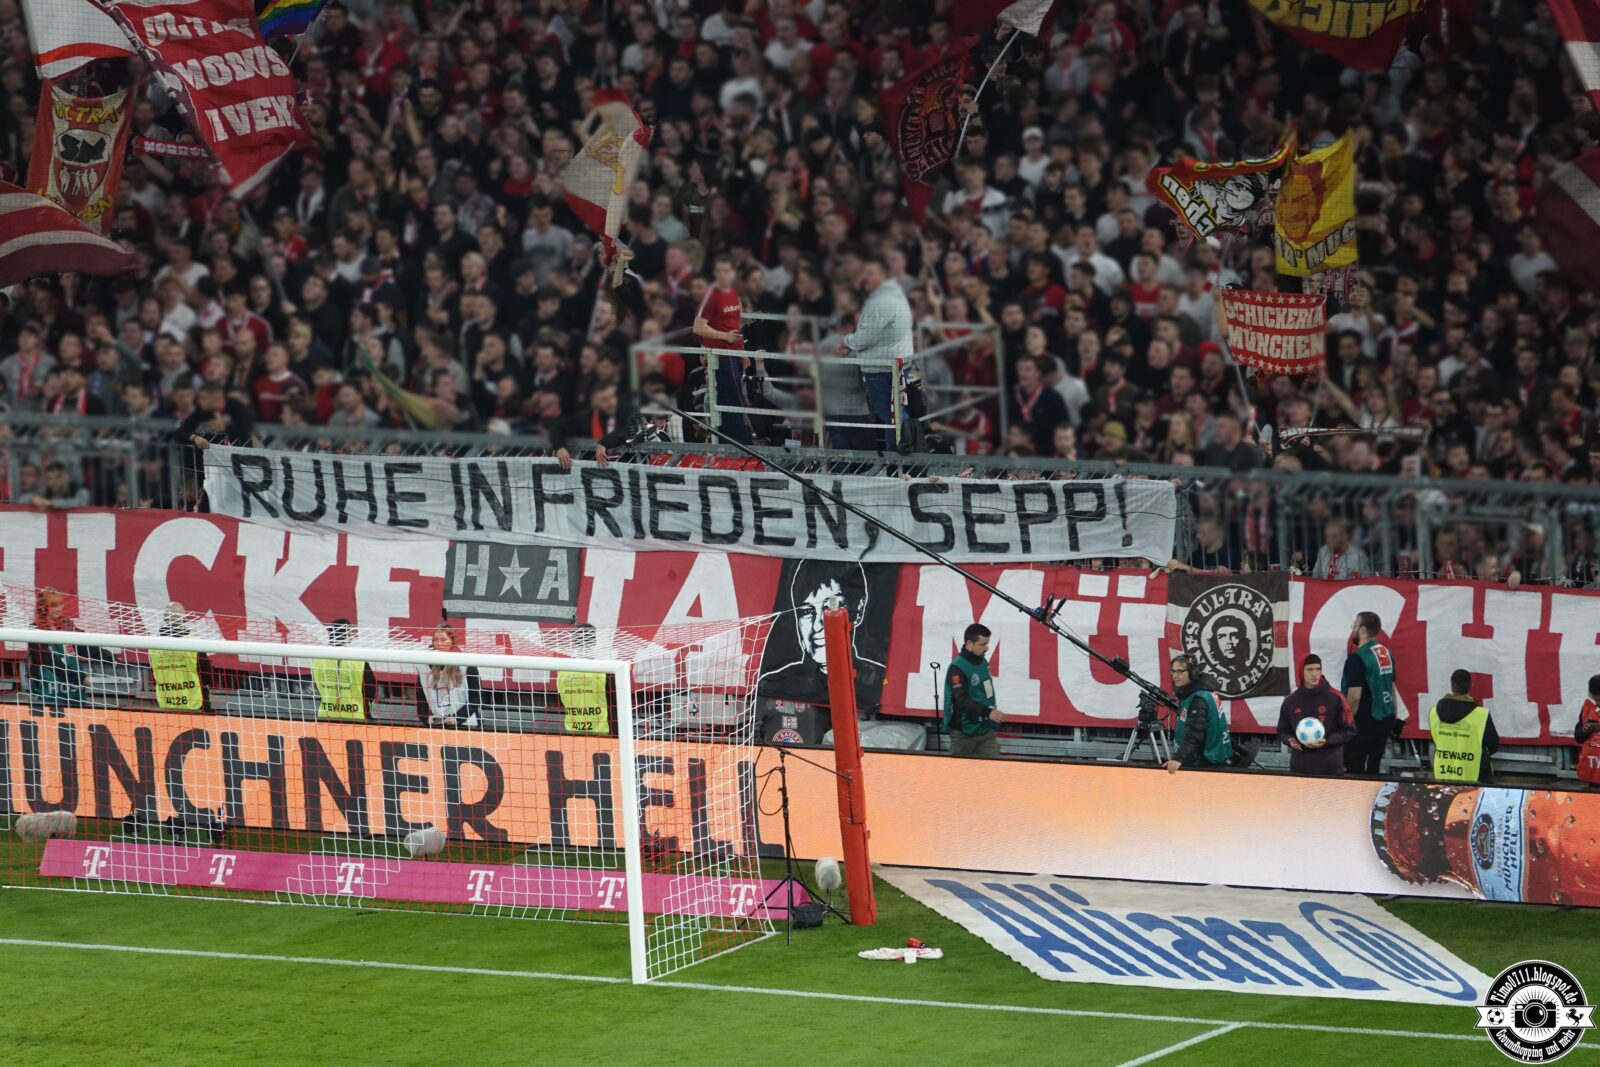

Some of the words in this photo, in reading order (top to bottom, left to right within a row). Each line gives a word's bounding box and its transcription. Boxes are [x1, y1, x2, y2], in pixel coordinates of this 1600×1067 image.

[1224, 300, 1324, 330] SCHICKERIA
[1227, 323, 1325, 360] MÜNCHEN
[231, 453, 430, 528] RUHE
[450, 460, 513, 532] IN
[534, 462, 879, 560] FRIEDEN,
[907, 479, 1134, 556] SEPP!
[157, 680, 196, 692] TEWARD
[1238, 628, 1274, 692] PAULI
[321, 702, 359, 713] TEWARD
[0, 704, 509, 843] ÜNCHNER
[545, 749, 785, 860] HELL
[1501, 803, 1515, 892] MÜNCHNER
[1509, 830, 1519, 870] HELL
[923, 878, 1390, 990] Allianz
